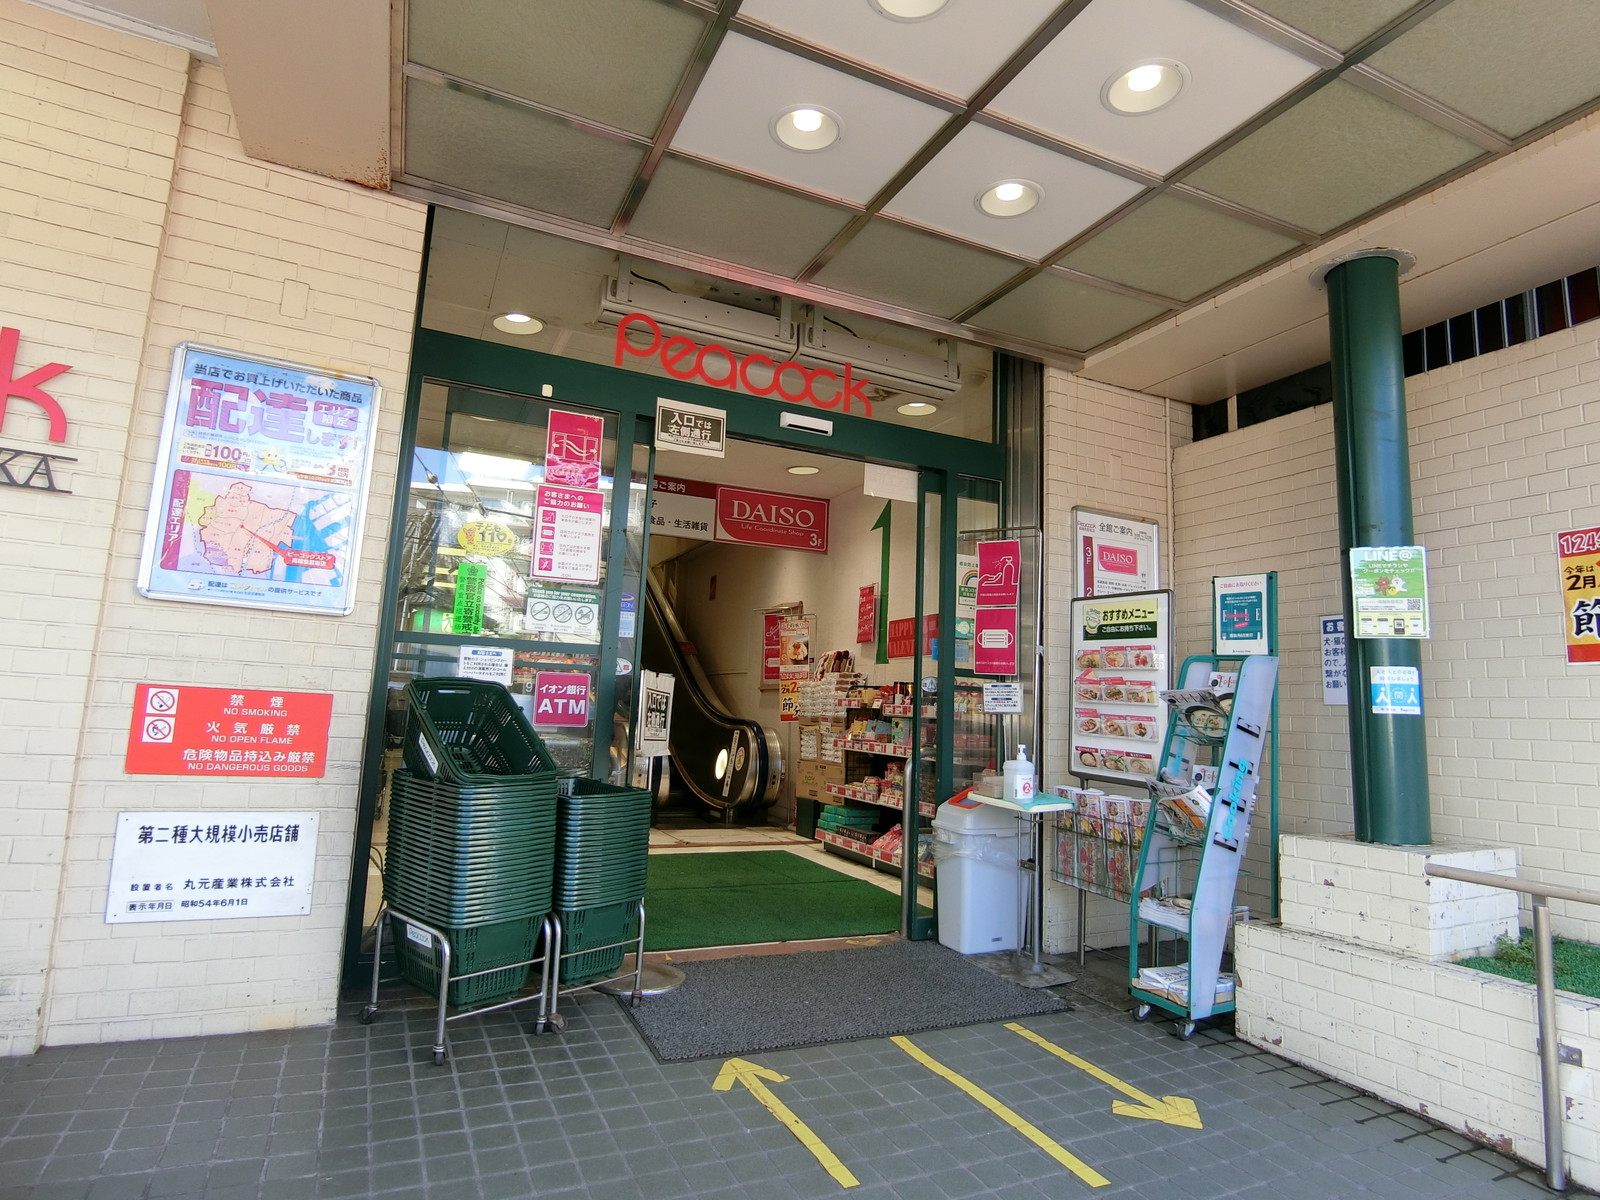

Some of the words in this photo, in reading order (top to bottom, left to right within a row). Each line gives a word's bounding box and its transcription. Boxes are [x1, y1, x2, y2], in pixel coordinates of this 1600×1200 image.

[614, 313, 873, 418] Peacock
[194, 363, 363, 404] 当店でお買上げいただいた商品
[186, 377, 308, 443] 配達
[670, 412, 713, 430] 入口では
[667, 424, 713, 441] 左側通行
[544, 490, 584, 501] お客さまへの
[543, 499, 590, 510] ご協力のお願い
[166, 498, 186, 543] 配達エリア
[732, 500, 815, 528] DAISO
[1099, 522, 1134, 537] 全館ご案内
[810, 534, 823, 548] 3F
[1560, 533, 1600, 555] 124
[1103, 551, 1134, 565] DAISO
[1364, 550, 1412, 562] LINE@
[1102, 610, 1155, 622] おすすめメニュー
[540, 684, 587, 695] イオン銀行
[230, 694, 284, 708] 禁煙
[538, 698, 586, 715] ATM
[224, 706, 238, 715] NO
[242, 708, 287, 718] SMOKING
[206, 721, 301, 736] 火気厳禁
[211, 734, 227, 743] NO
[229, 735, 257, 744] OPEN
[260, 737, 294, 746] FLAME
[183, 748, 316, 765] 危険物品持込み厳禁
[188, 762, 204, 771] NO
[206, 763, 271, 773] DANGEROUS
[273, 765, 309, 774] GOODS
[138, 824, 300, 845] 第二種大規模小売店舗
[131, 883, 174, 893] 設置者名
[184, 876, 295, 891] 丸元産業株式会社
[129, 901, 173, 912] 表示年月日
[181, 898, 249, 909] 昭和54年6月1日
